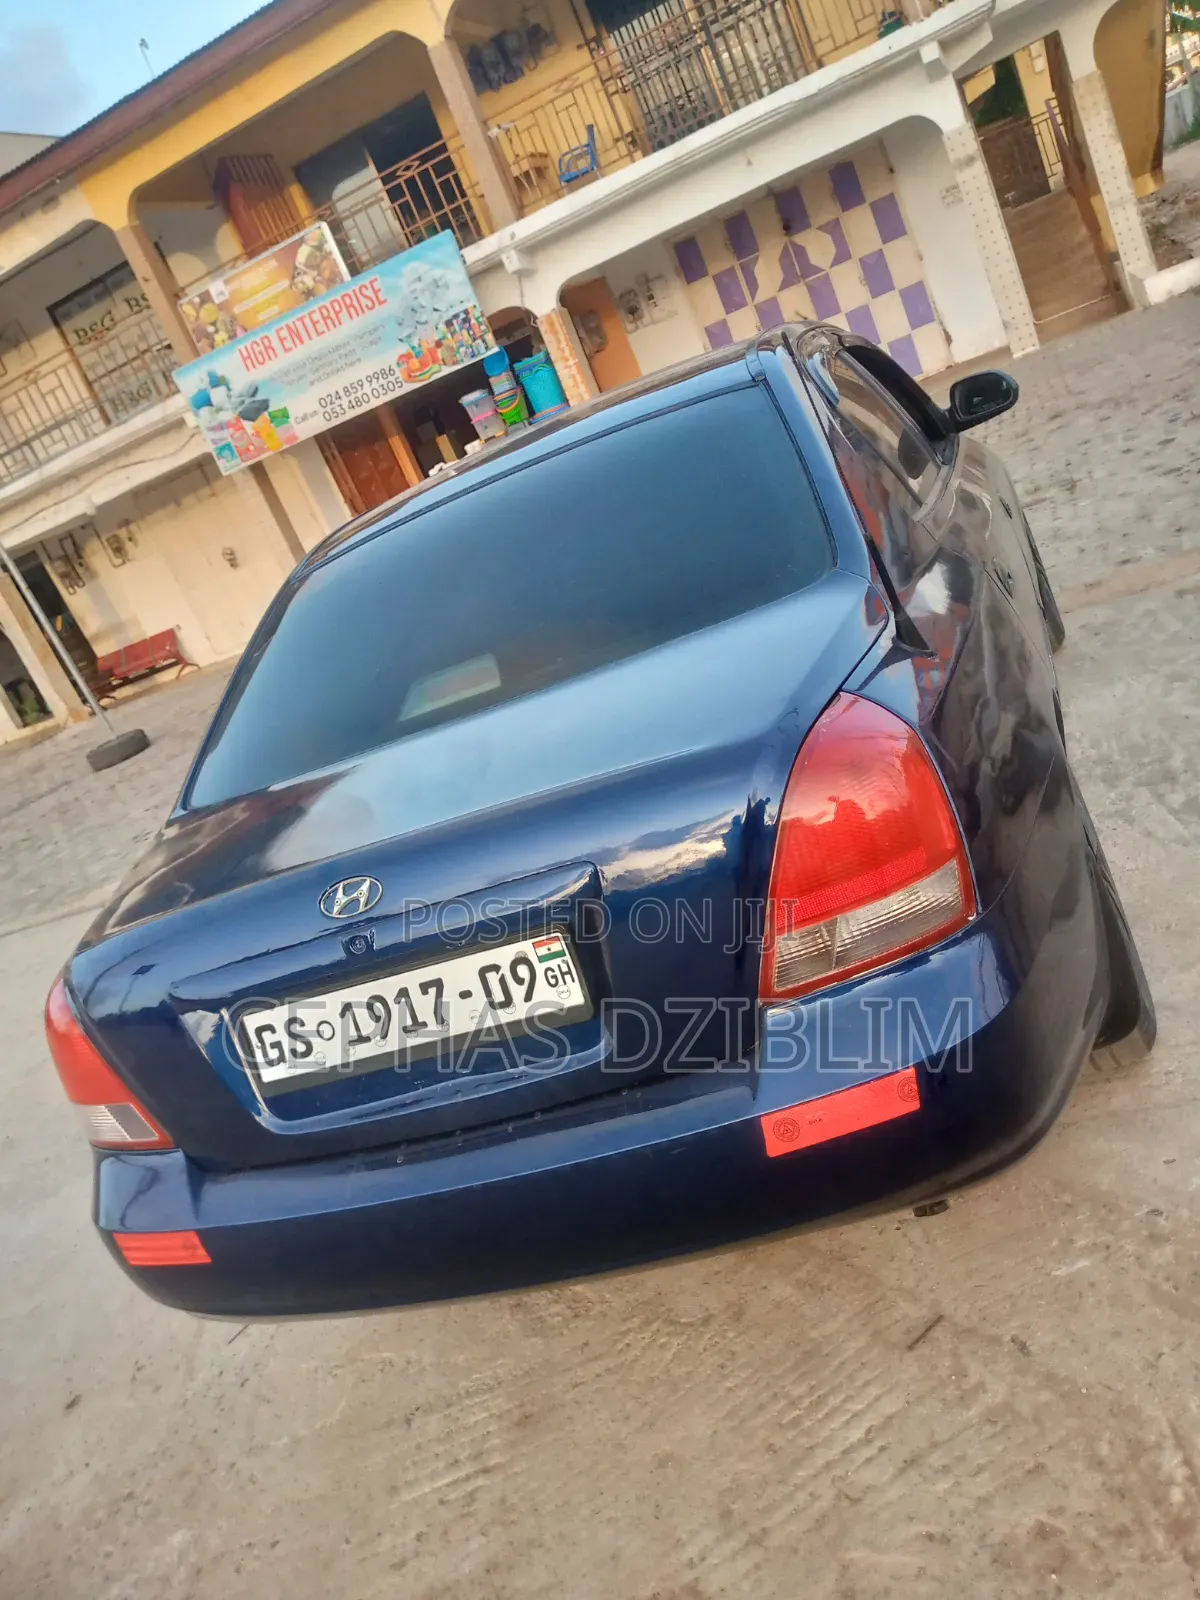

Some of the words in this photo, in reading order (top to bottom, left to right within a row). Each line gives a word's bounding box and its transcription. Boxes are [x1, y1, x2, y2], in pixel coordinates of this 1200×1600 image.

[238, 335, 278, 372] HGR
[275, 277, 387, 353] ENTERPRISE
[319, 390, 342, 409] 024
[343, 379, 364, 398] 859
[365, 364, 396, 387] 9986
[323, 404, 346, 422] 053
[348, 392, 370, 411] 480
[371, 377, 403, 399] 0305
[544, 962, 576, 988] GH
[254, 1019, 314, 1067] GS
